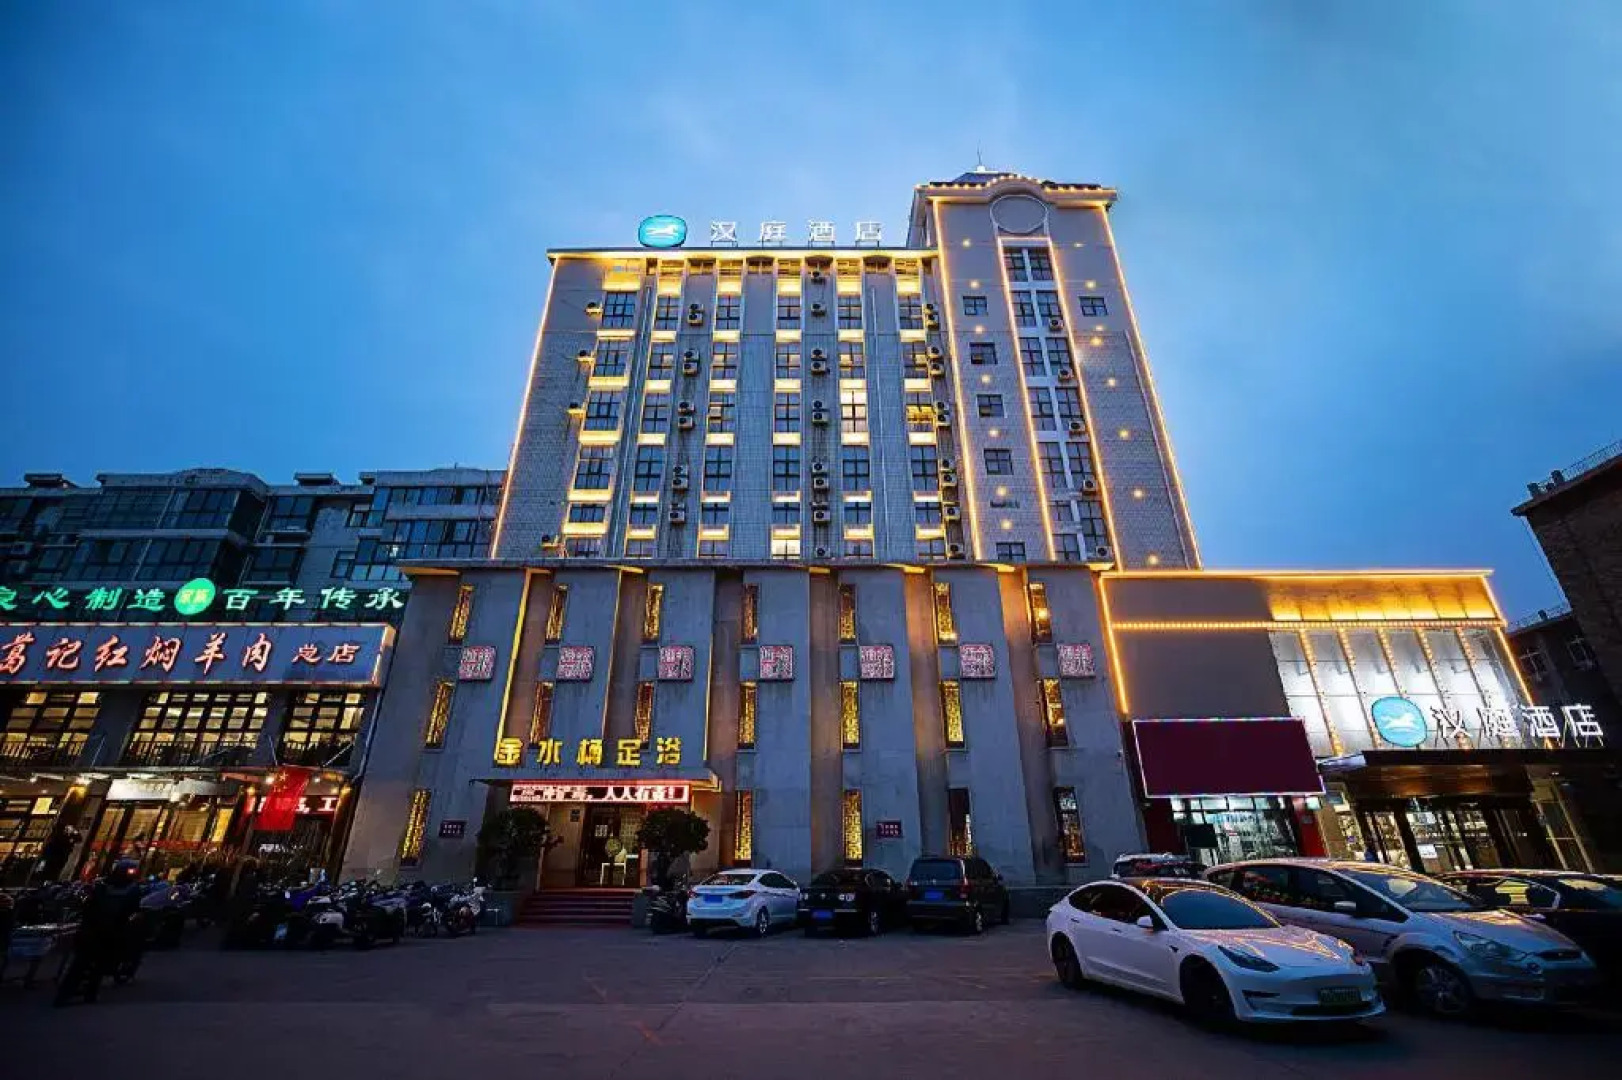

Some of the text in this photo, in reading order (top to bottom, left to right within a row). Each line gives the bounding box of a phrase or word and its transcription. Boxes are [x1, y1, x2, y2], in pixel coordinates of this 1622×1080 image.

[710, 220, 883, 242] 汉庭酒店
[222, 588, 404, 611] 百年传承
[291, 643, 361, 663] 总店
[1430, 704, 1604, 738] 汉庭酒店
